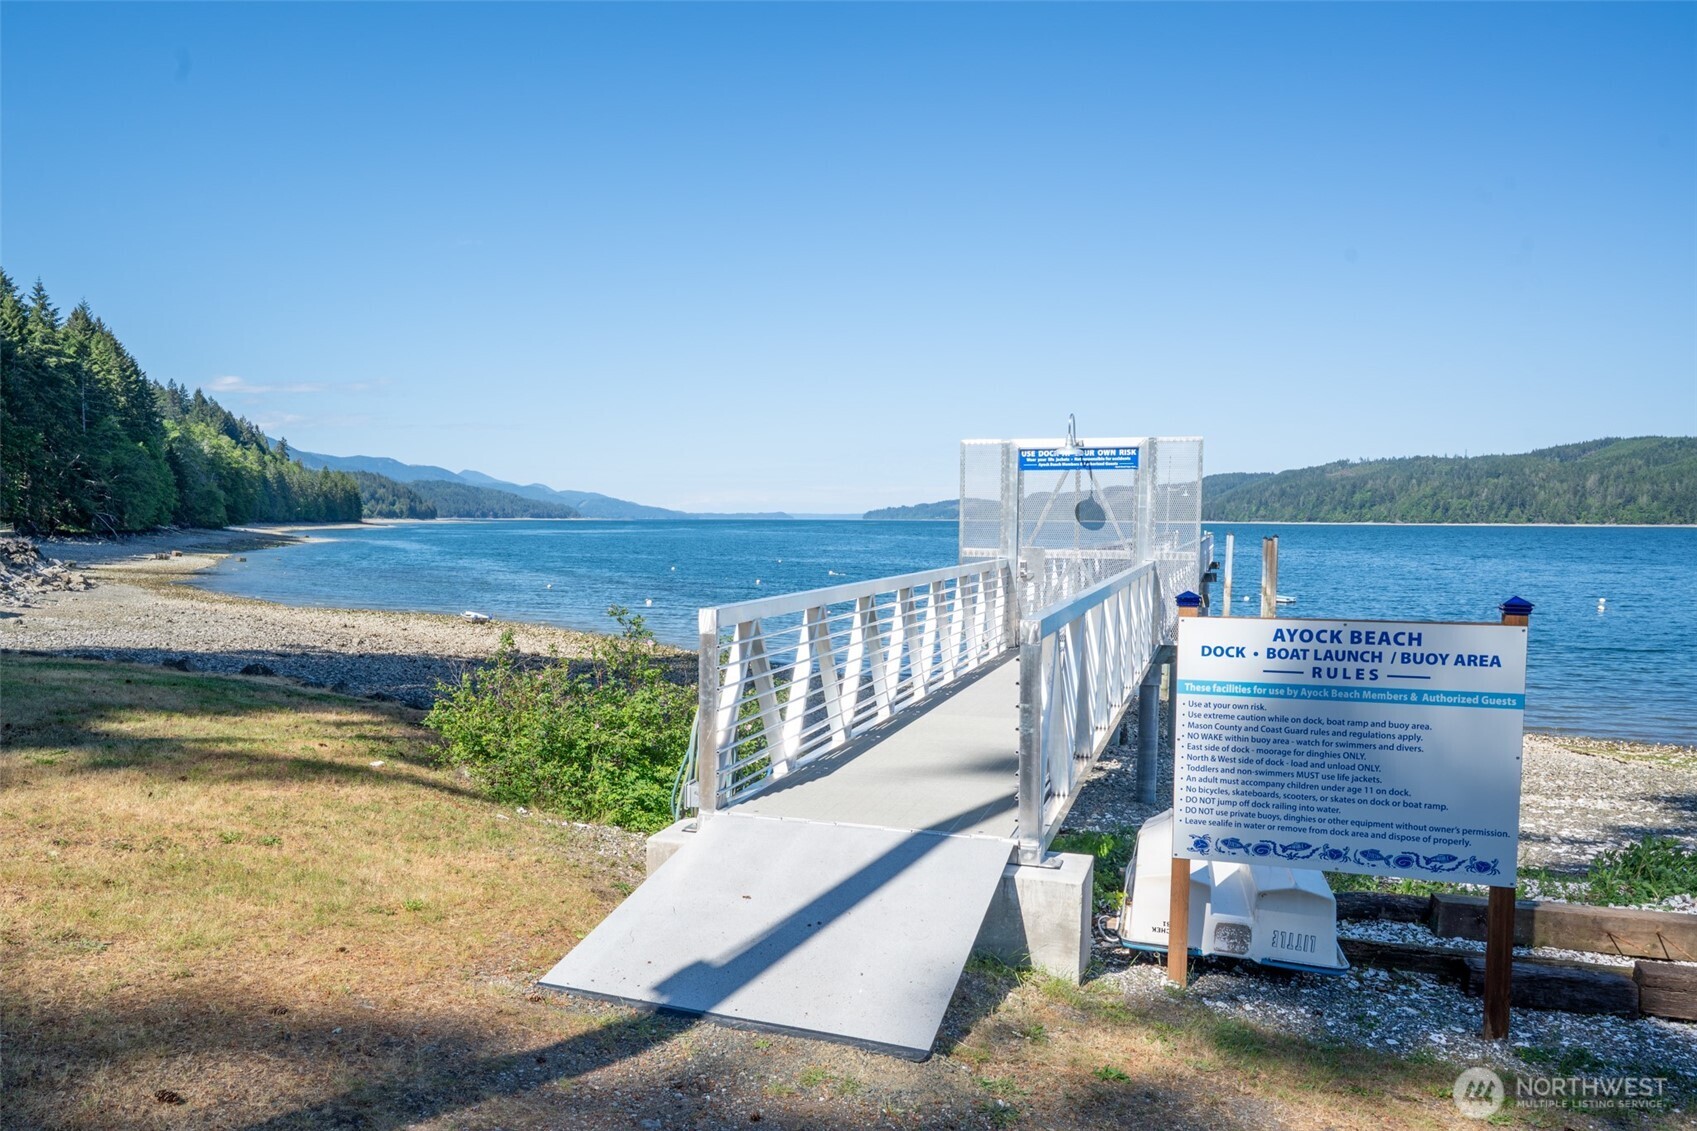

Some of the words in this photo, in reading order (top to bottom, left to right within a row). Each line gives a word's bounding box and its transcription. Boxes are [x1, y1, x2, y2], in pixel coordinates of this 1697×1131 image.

[1119, 448, 1137, 456] RISK
[1272, 628, 1343, 644] AYOCK
[1350, 630, 1422, 647] BEACH
[1200, 644, 1246, 658] DOCK
[1266, 647, 1310, 660] BOAT
[1313, 648, 1382, 663] LAUNCH
[1400, 651, 1450, 666] BUOY
[1453, 653, 1502, 668] AREA
[1311, 666, 1379, 681] RULES
[1184, 682, 1211, 692] These
[1212, 683, 1251, 694] facilities
[1252, 684, 1267, 695] for
[1286, 686, 1298, 698] by
[1300, 687, 1329, 698] Ayock
[1331, 688, 1360, 698] Beach
[1362, 690, 1408, 701] Members
[1409, 692, 1418, 702] &
[1421, 692, 1479, 704] Authorized
[1481, 695, 1517, 706] Guests
[1188, 700, 1202, 708] Use
[1212, 702, 1231, 710] your
[1250, 702, 1266, 711] risk.
[1187, 710, 1202, 719] Use
[1202, 712, 1235, 720] extreme
[1236, 713, 1266, 722] caution
[1267, 714, 1289, 723] while
[1302, 716, 1324, 726] dock,
[1326, 717, 1345, 726] boat
[1346, 720, 1369, 729] ramp
[1370, 720, 1387, 728] and
[1387, 720, 1410, 731] buoy
[1186, 731, 1200, 740] NO
[1200, 732, 1223, 742] WAKE
[1224, 734, 1249, 742] within
[1250, 735, 1271, 746] buoy
[1295, 738, 1320, 747] watch
[1321, 739, 1333, 748] for
[1335, 740, 1376, 750] swimmers
[1378, 742, 1395, 751] and
[1395, 743, 1424, 753] divers.
[1187, 721, 1213, 730] Mason
[1214, 722, 1242, 733] County
[1243, 724, 1259, 732] and
[1260, 724, 1282, 734] Coast
[1283, 726, 1309, 735] Guard
[1310, 727, 1330, 736] rules
[1331, 729, 1348, 737] and
[1348, 730, 1396, 740] regulations
[1397, 732, 1423, 743] apply.
[1186, 742, 1203, 751] East
[1204, 743, 1220, 752] side
[1221, 744, 1230, 752] of
[1230, 744, 1250, 754] dock
[1256, 748, 1292, 758] moorage
[1292, 748, 1304, 757] for
[1305, 749, 1341, 760] dinghies
[1342, 751, 1366, 760] ONLY.
[1186, 753, 1209, 762] North
[1210, 754, 1217, 762] &
[1217, 754, 1236, 764] West
[1238, 756, 1254, 765] side
[1255, 757, 1264, 765] of
[1264, 757, 1284, 766] dock
[1290, 759, 1308, 768] load
[1309, 761, 1326, 769] and
[1326, 762, 1356, 771] unload
[1357, 763, 1381, 772] ONLY.
[1186, 763, 1219, 773] Toddlers
[1220, 766, 1236, 774] and
[1236, 768, 1294, 778] non-swimmers
[1296, 770, 1320, 779] MUST
[1336, 772, 1350, 782] life
[1351, 773, 1382, 784] jackets.
[1185, 774, 1197, 782] An
[1198, 774, 1218, 784] adult
[1219, 777, 1239, 786] must
[1240, 780, 1285, 790] accompany
[1286, 780, 1319, 790] children
[1320, 783, 1345, 792] under
[1346, 786, 1362, 795] age
[1364, 786, 1373, 794] 11
[1388, 787, 1411, 797] dock.
[1185, 785, 1197, 793] No
[1197, 785, 1230, 796] bicycles,
[1231, 788, 1281, 800] skateboards,
[1282, 792, 1318, 802] scooters,
[1330, 794, 1356, 804] skates
[1369, 797, 1390, 806] dock
[1402, 799, 1422, 809] boat
[1423, 803, 1448, 812] ramp.
[1185, 795, 1198, 804] DO
[1198, 796, 1216, 805] NOT
[1216, 797, 1238, 808] jump
[1238, 799, 1250, 807] off
[1251, 800, 1270, 809] dock
[1271, 802, 1297, 813] railing
[1298, 803, 1315, 812] into
[1316, 806, 1341, 814] water.
[1184, 805, 1197, 814] DO
[1198, 806, 1214, 815] NOT
[1229, 809, 1256, 819] private
[1257, 810, 1282, 822] buoys,
[1282, 813, 1316, 824] dinghies
[1327, 816, 1349, 825] other
[1350, 819, 1394, 829] equipment
[1395, 821, 1427, 832] without
[1461, 828, 1510, 838] permission.
[1184, 816, 1207, 826] Leave
[1208, 818, 1233, 828] sealife
[1234, 820, 1242, 828] in
[1243, 822, 1266, 830] water
[1277, 825, 1307, 834] remove
[1308, 825, 1328, 835] from
[1329, 827, 1350, 836] dock
[1370, 831, 1387, 840] and
[1388, 832, 1421, 843] dispose
[1422, 834, 1432, 843] of
[1432, 837, 1471, 848] properly.
[1272, 930, 1316, 954] LITTLE
